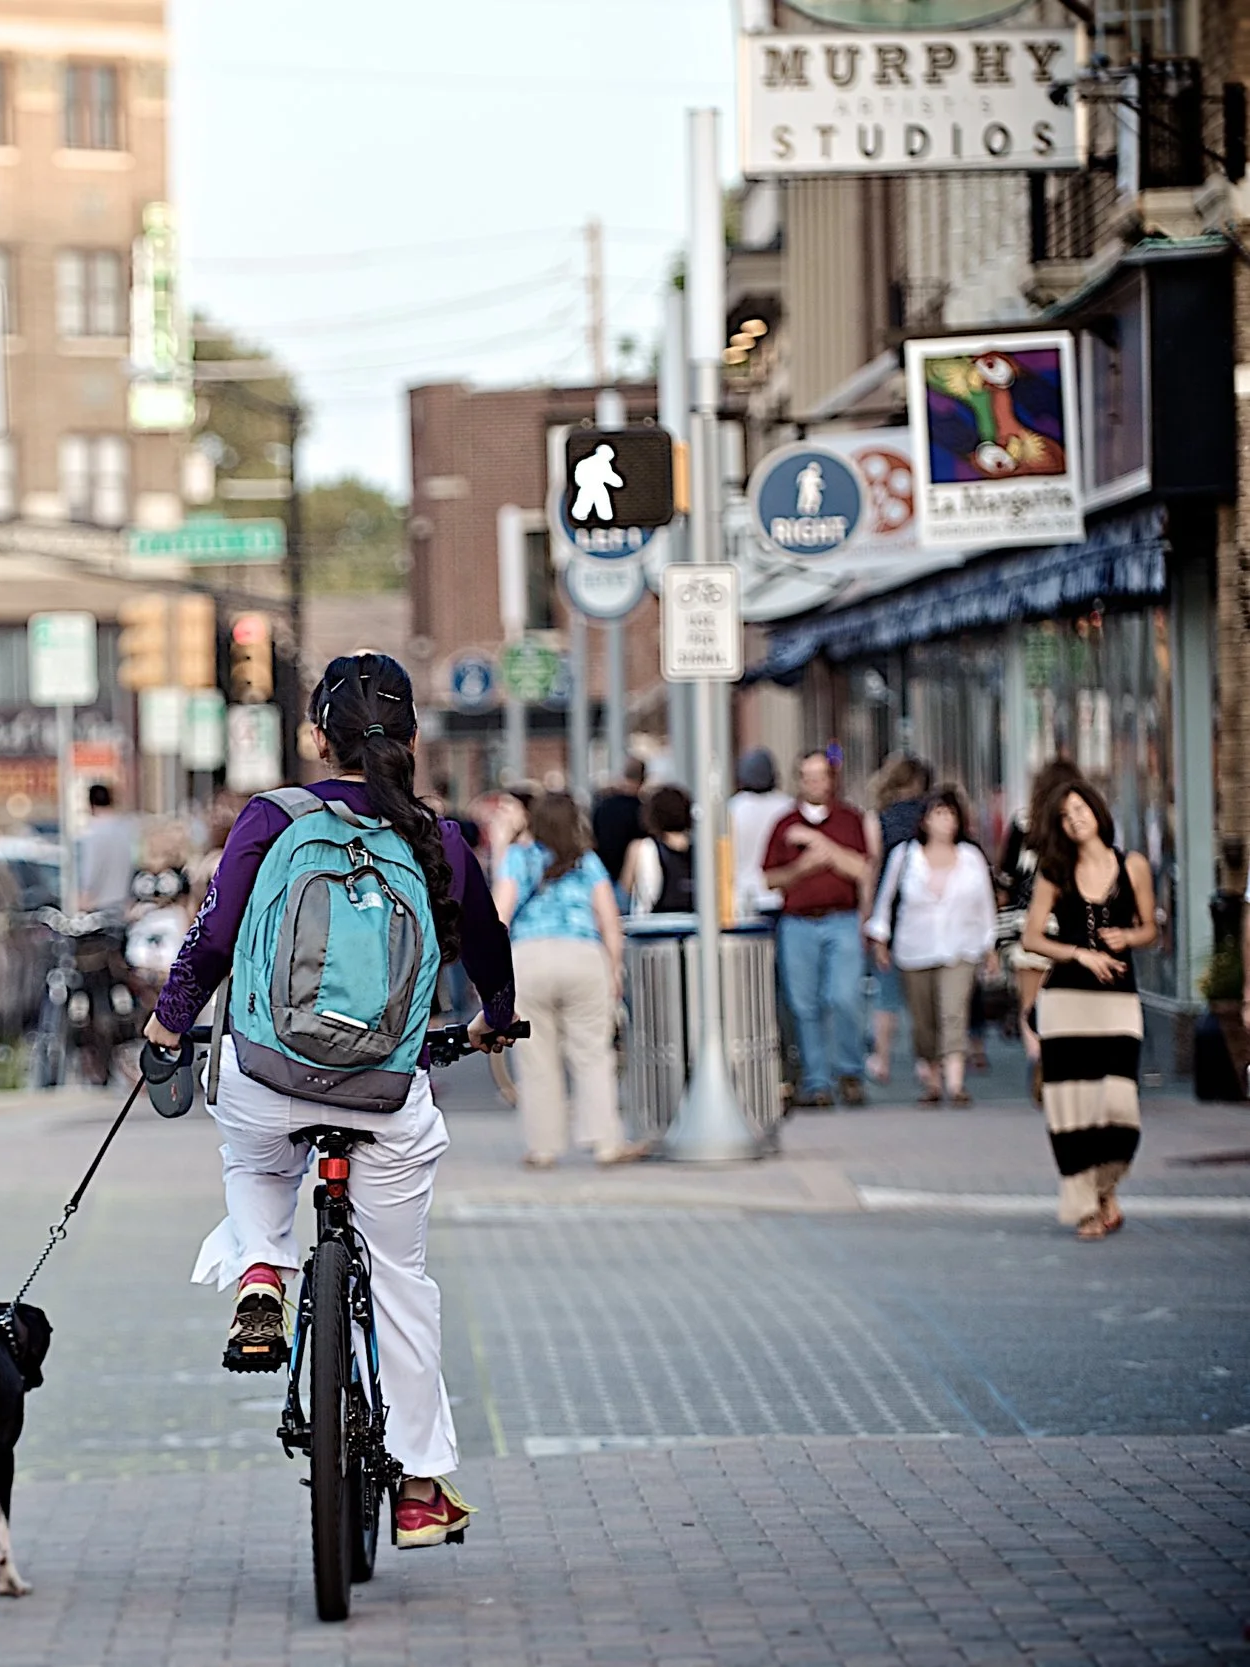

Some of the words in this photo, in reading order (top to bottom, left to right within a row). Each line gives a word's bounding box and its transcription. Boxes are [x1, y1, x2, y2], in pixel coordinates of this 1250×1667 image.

[761, 40, 1062, 90] MURPHY
[771, 120, 1056, 160] STUDIOS
[770, 513, 848, 547] RIGHT
